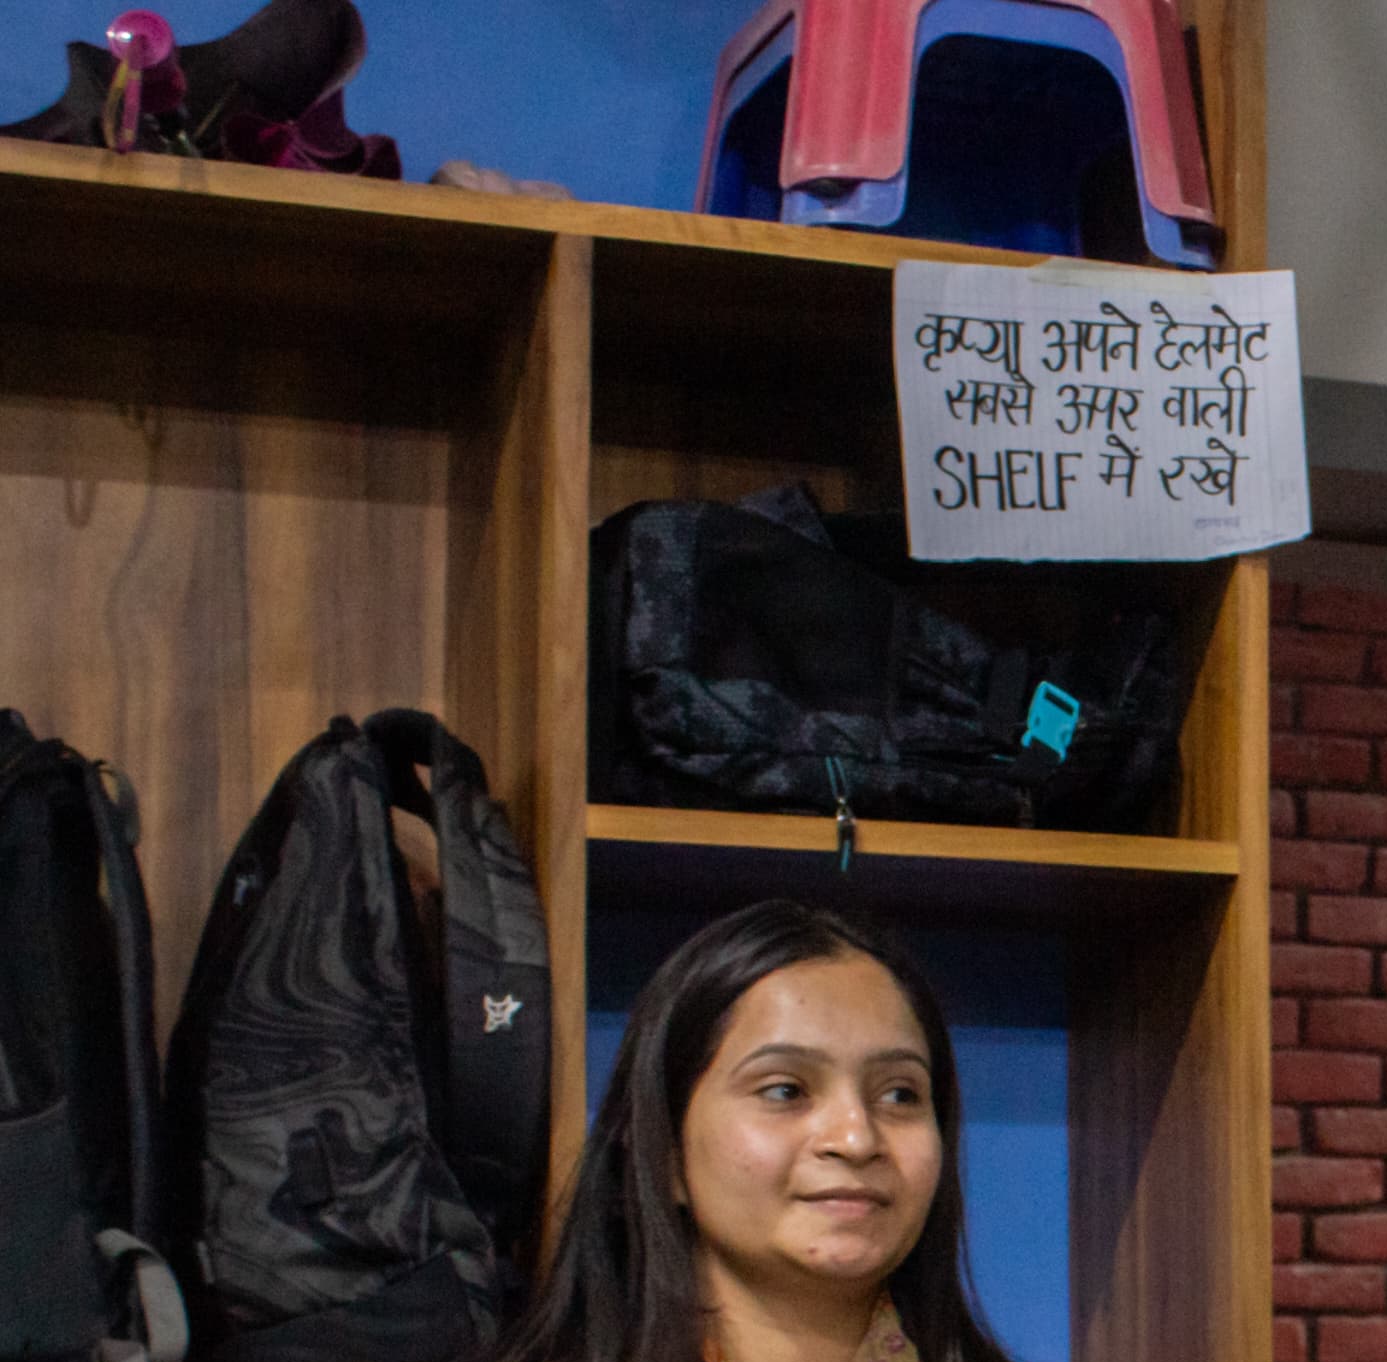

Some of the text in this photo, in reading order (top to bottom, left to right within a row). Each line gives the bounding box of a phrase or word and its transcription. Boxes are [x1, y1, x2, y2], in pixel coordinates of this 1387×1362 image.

[1042, 302, 1141, 372] अपने
[945, 370, 1036, 427] सबसे
[1162, 366, 1256, 437] वाली
[933, 444, 1083, 512] SHELF
[1098, 433, 1143, 498] में
